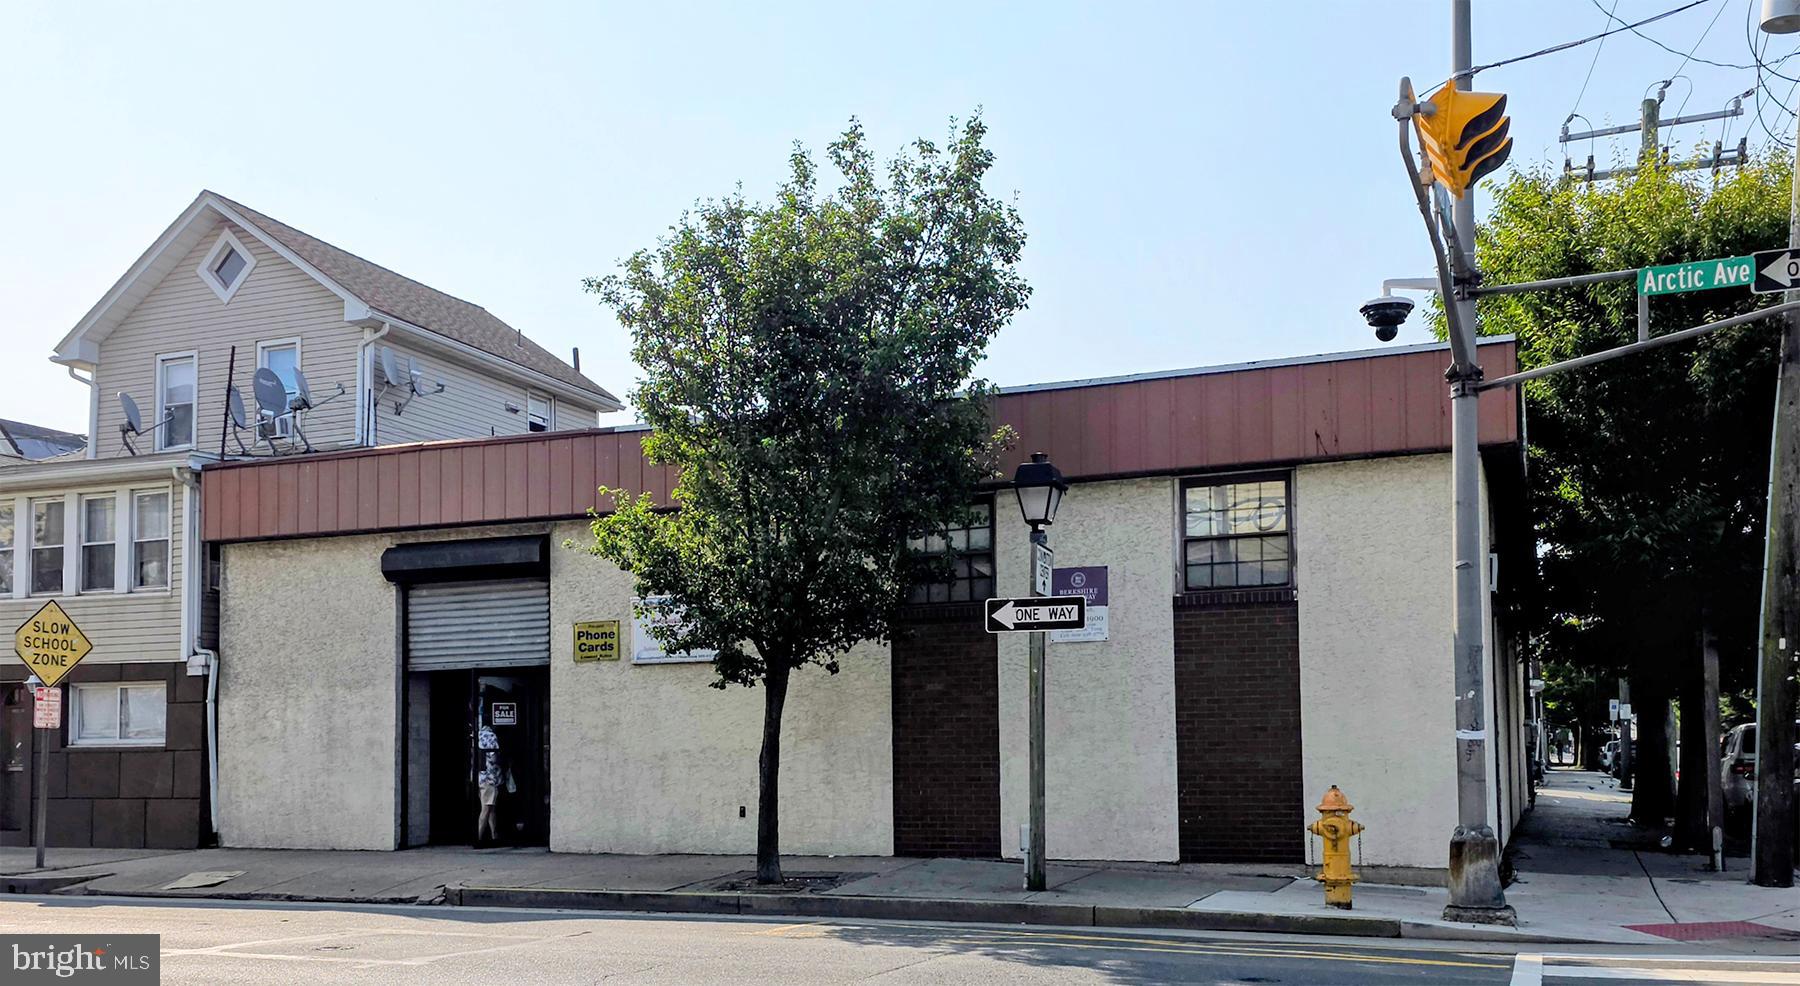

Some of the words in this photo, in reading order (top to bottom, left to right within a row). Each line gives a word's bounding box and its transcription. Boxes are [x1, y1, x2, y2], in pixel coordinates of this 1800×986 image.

[1644, 265, 1704, 293] Arctic
[1714, 262, 1749, 286] Ave
[1059, 587, 1099, 596] BERKSHIRE
[1015, 608, 1040, 622] ONE
[1048, 607, 1075, 620] WAY
[33, 621, 70, 635] SLOW
[577, 630, 616, 641] Phone
[24, 636, 77, 652] SCHOOL
[578, 641, 614, 653] Cards
[32, 653, 68, 667] ZONE
[494, 710, 515, 718] SALE
